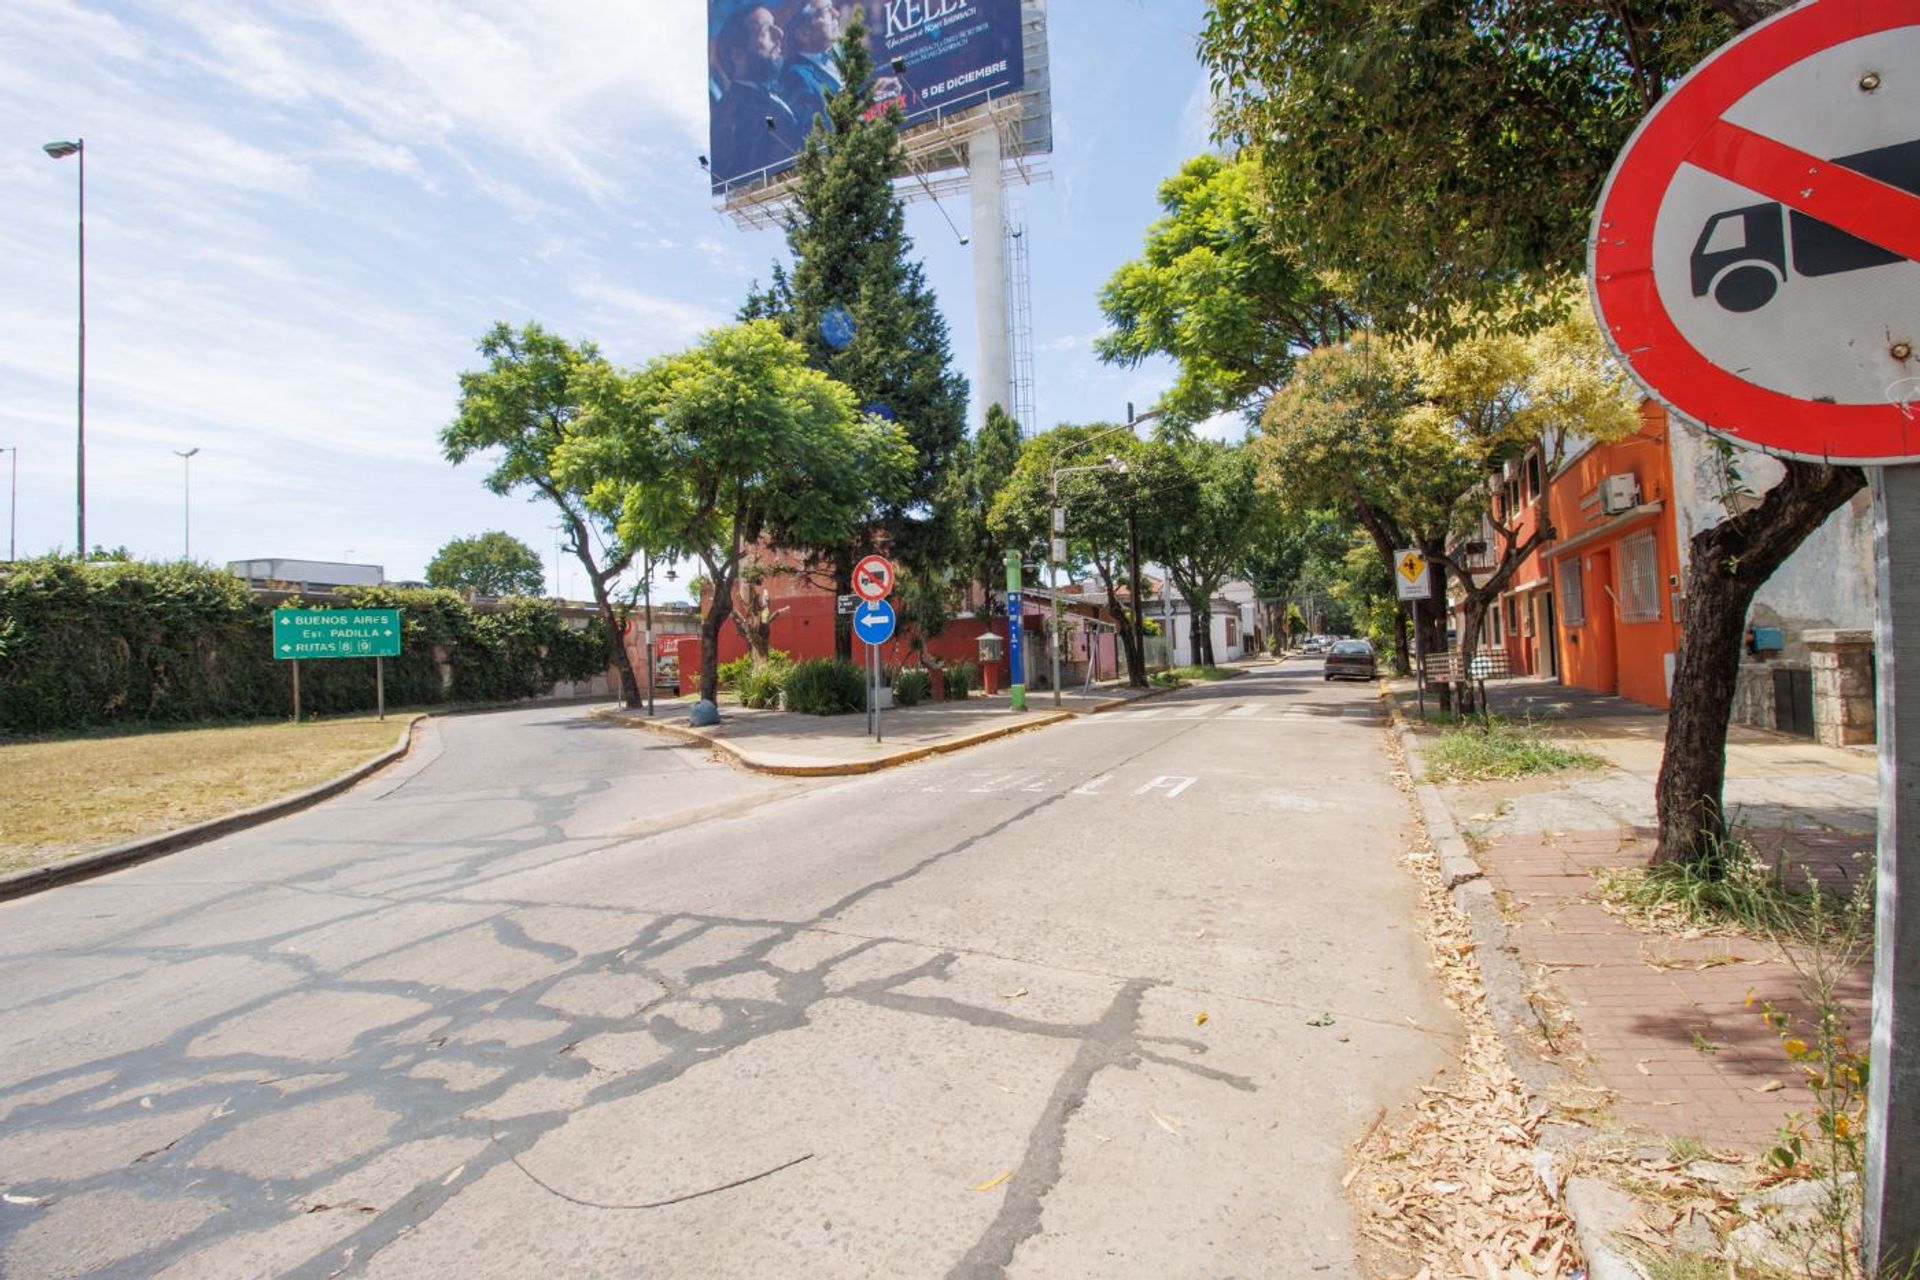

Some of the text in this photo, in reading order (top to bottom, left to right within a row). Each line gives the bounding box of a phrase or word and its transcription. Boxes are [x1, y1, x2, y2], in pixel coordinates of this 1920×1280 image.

[884, 0, 967, 38] KELL
[921, 88, 929, 99] 5
[930, 83, 945, 95] DE
[946, 60, 1007, 90] DICIEMBRE
[295, 615, 388, 625] BUENOS AIRES
[330, 629, 379, 638] PADILLA
[296, 641, 369, 652] RUTAS 8 9
